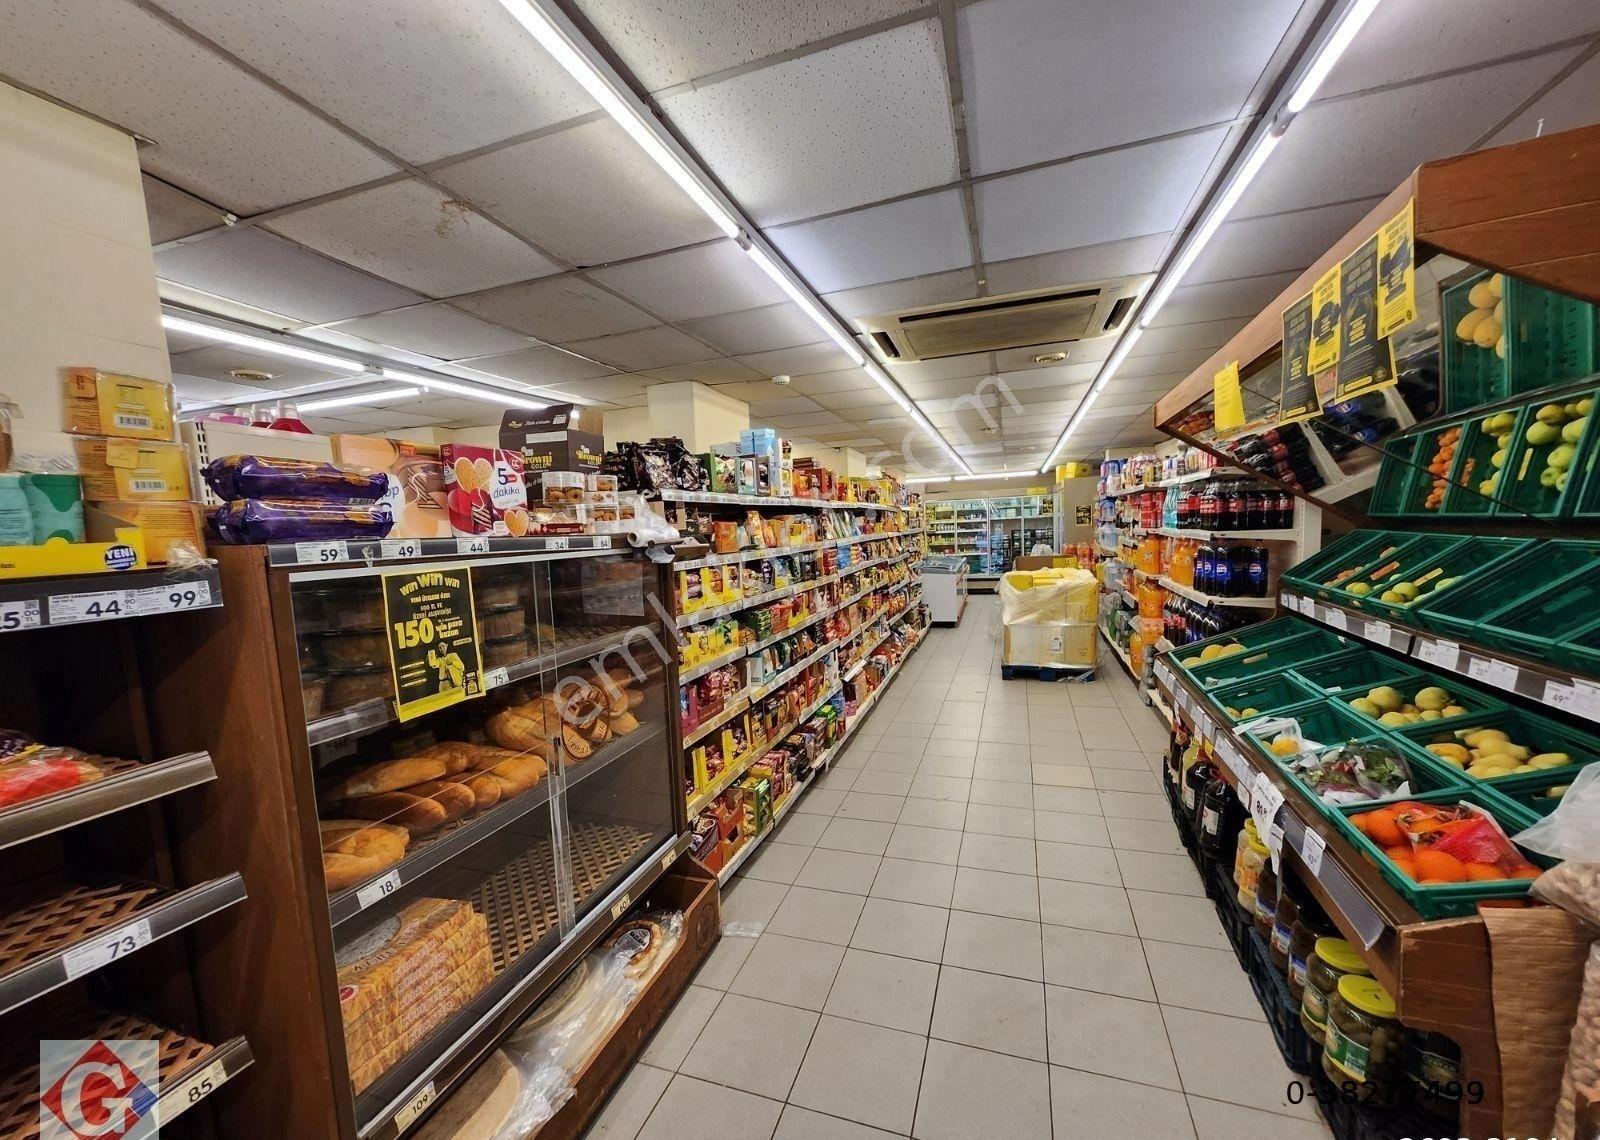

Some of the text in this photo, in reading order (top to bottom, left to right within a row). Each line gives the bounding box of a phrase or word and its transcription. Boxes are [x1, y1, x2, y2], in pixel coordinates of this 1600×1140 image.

[493, 486, 520, 500] dakika
[320, 549, 338, 562] 59
[398, 546, 414, 557] 49
[470, 543, 484, 553] 44
[168, 590, 196, 608] 99
[85, 601, 121, 617] 44
[394, 617, 434, 649] 150
[493, 674, 504, 686] 75
[379, 880, 394, 895] 18
[106, 935, 136, 959] 73
[188, 1077, 213, 1103] 85
[412, 1093, 429, 1115] 109
